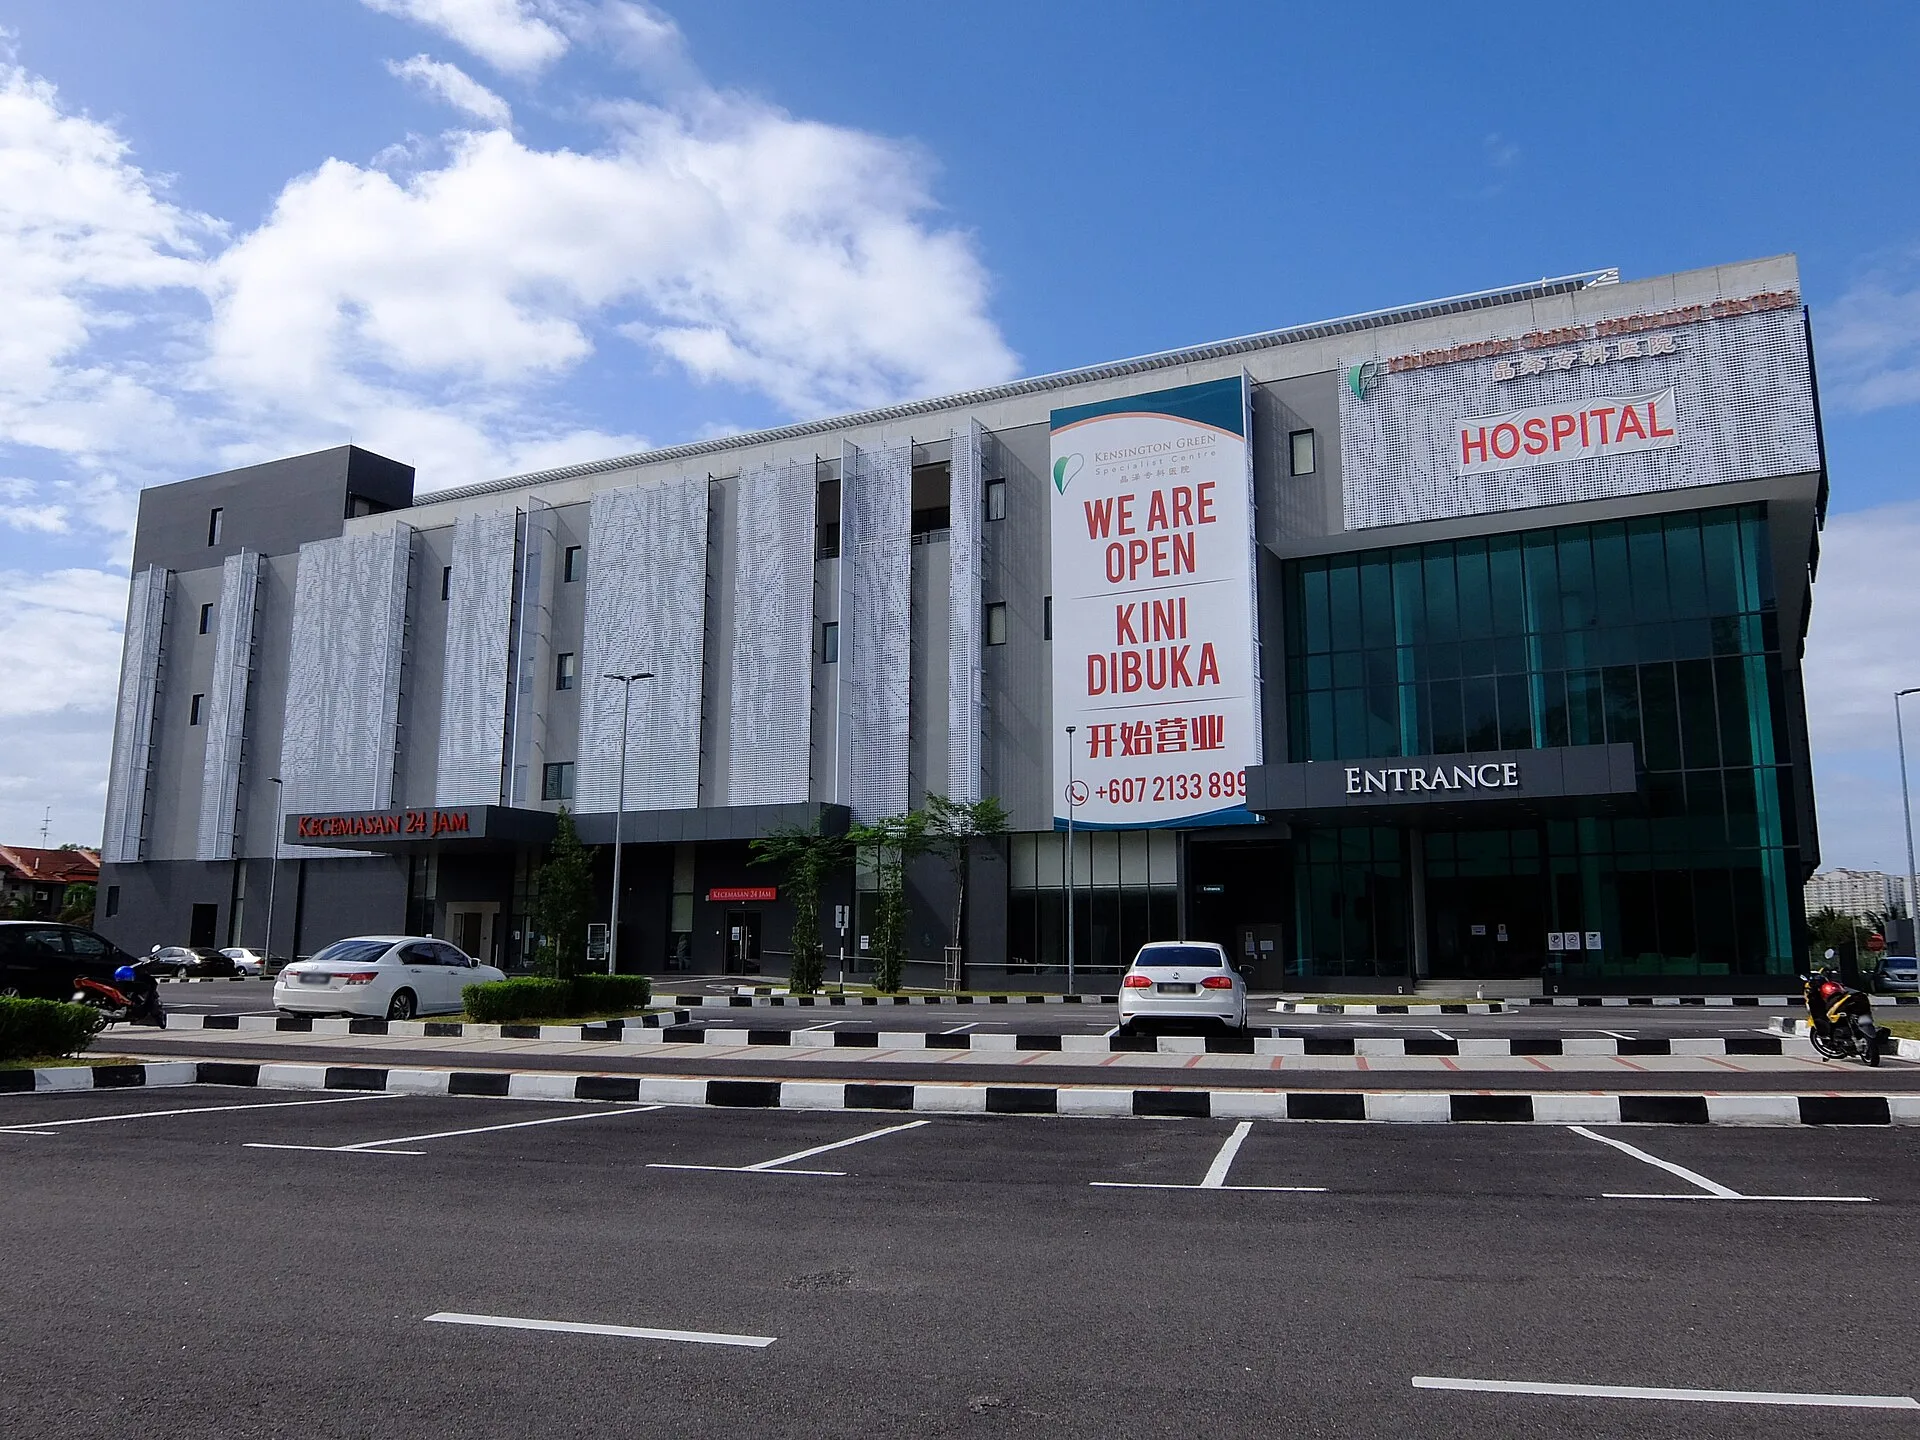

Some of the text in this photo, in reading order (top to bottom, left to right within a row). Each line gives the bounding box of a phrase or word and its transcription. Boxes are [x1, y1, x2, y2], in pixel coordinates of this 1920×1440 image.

[1461, 401, 1674, 464] HOSPITAL
[1095, 450, 1217, 477] Specialist Centre
[1084, 481, 1217, 539] WE ARE
[1105, 531, 1196, 583] OPEN
[1116, 597, 1187, 645] KINI
[1087, 642, 1220, 696] DIBUKA
[1086, 714, 1225, 759] 开始营业
[1095, 777, 1147, 804] +607
[1152, 773, 1203, 801] 2133
[1344, 762, 1519, 794] ENTRANCE
[299, 811, 469, 838] KECEMASAN 24 JAM
[750, 890, 757, 898] 24
